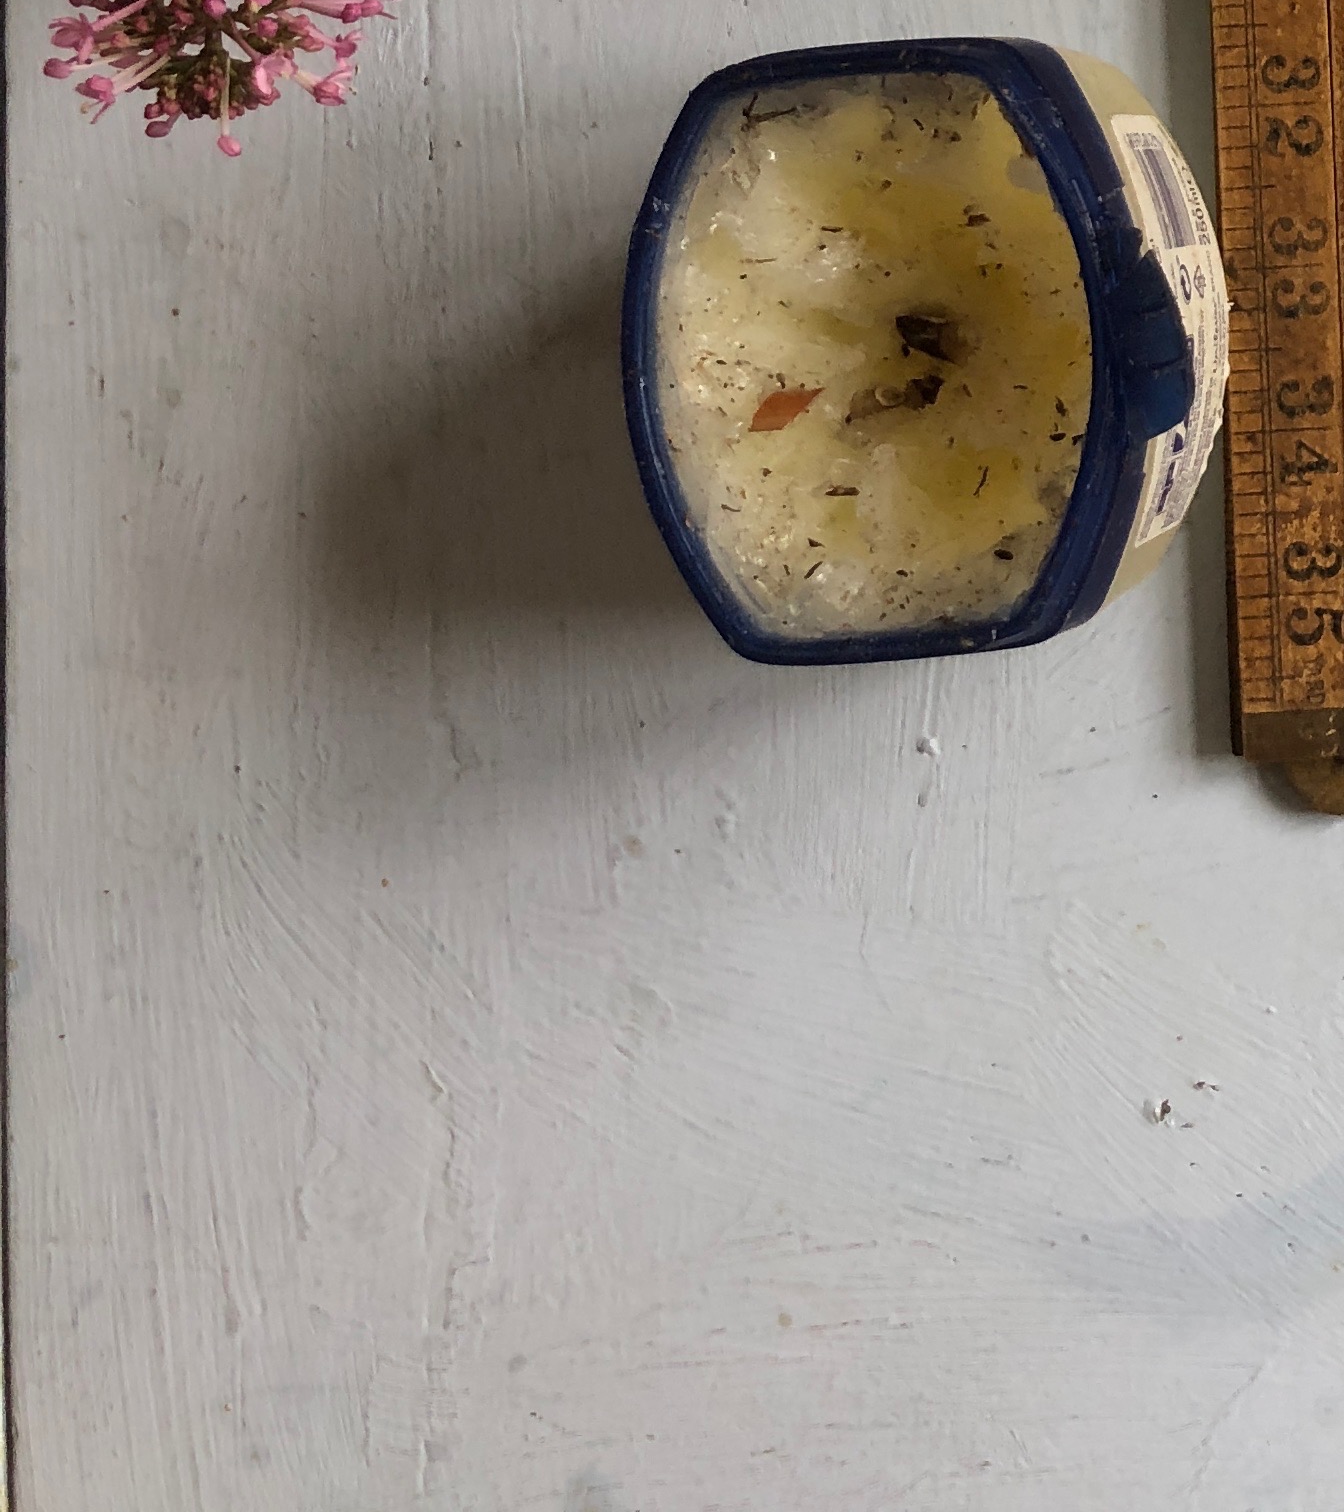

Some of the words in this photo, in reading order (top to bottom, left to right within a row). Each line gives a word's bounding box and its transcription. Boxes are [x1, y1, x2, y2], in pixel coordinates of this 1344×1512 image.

[1260, 54, 1325, 159] 32
[1268, 215, 1331, 320] 33
[1275, 374, 1340, 487] 34
